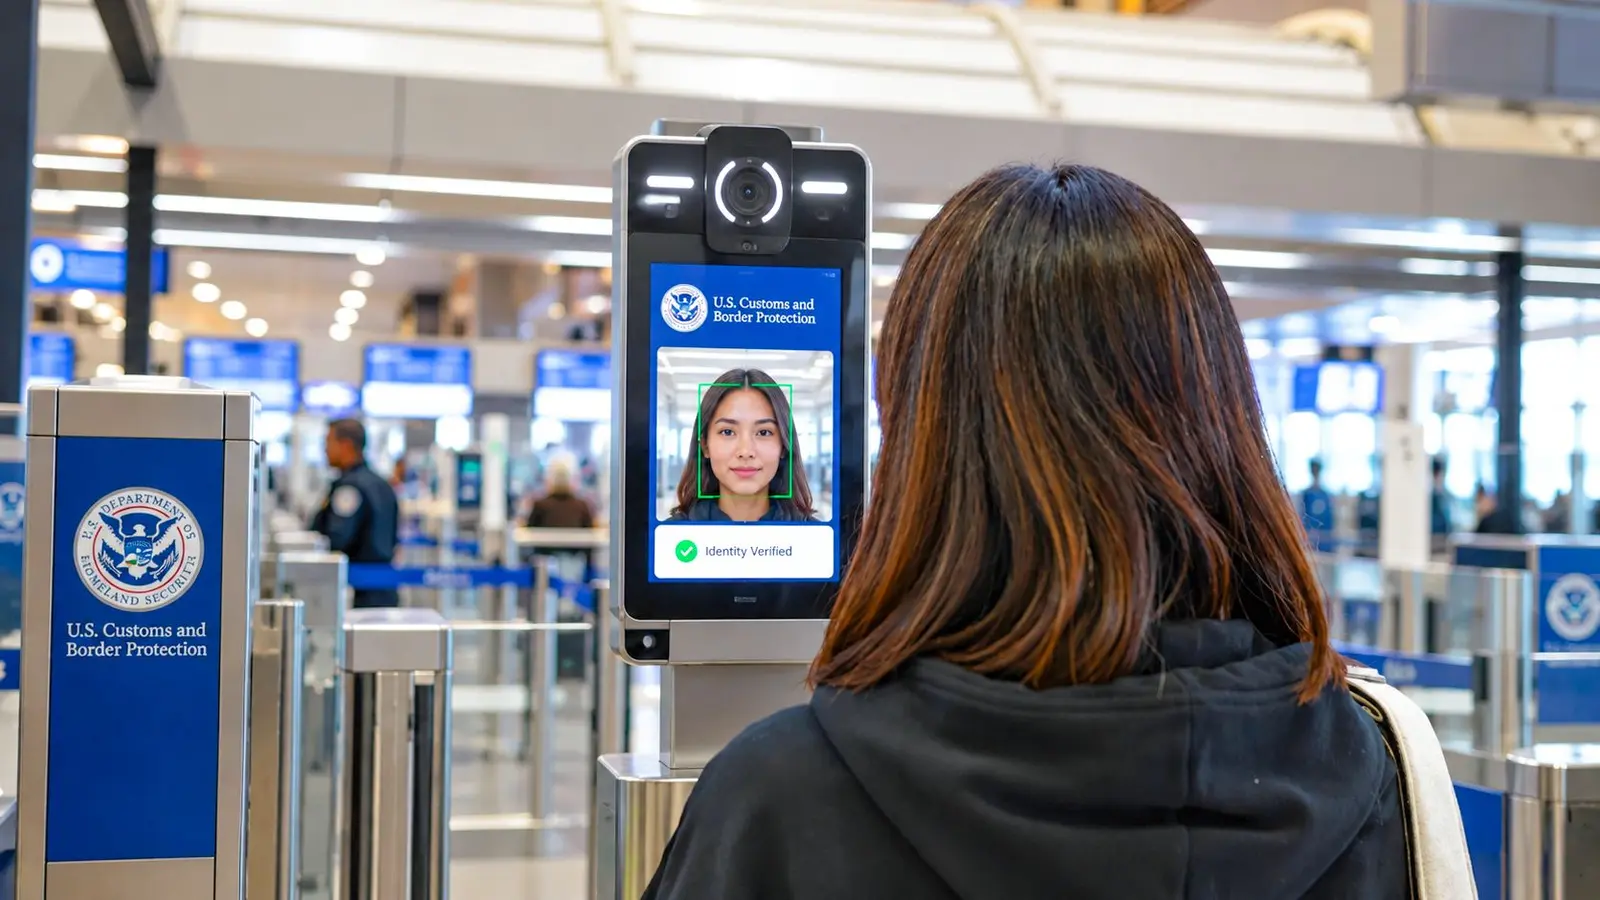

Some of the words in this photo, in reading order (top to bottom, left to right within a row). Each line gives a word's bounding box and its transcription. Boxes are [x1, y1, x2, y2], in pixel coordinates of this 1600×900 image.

[713, 296, 737, 308] U.S.
[739, 297, 790, 310] Customs
[792, 298, 815, 310] and
[713, 310, 753, 323] Border
[756, 311, 816, 324] Protection
[101, 493, 186, 521] DEPARTMENT
[705, 546, 747, 559] Identity
[750, 546, 793, 557] Verified
[66, 622, 99, 638] U.S.
[102, 622, 173, 638] Customs
[176, 621, 207, 638] and
[66, 641, 122, 657] Border
[126, 641, 208, 657] Protection
